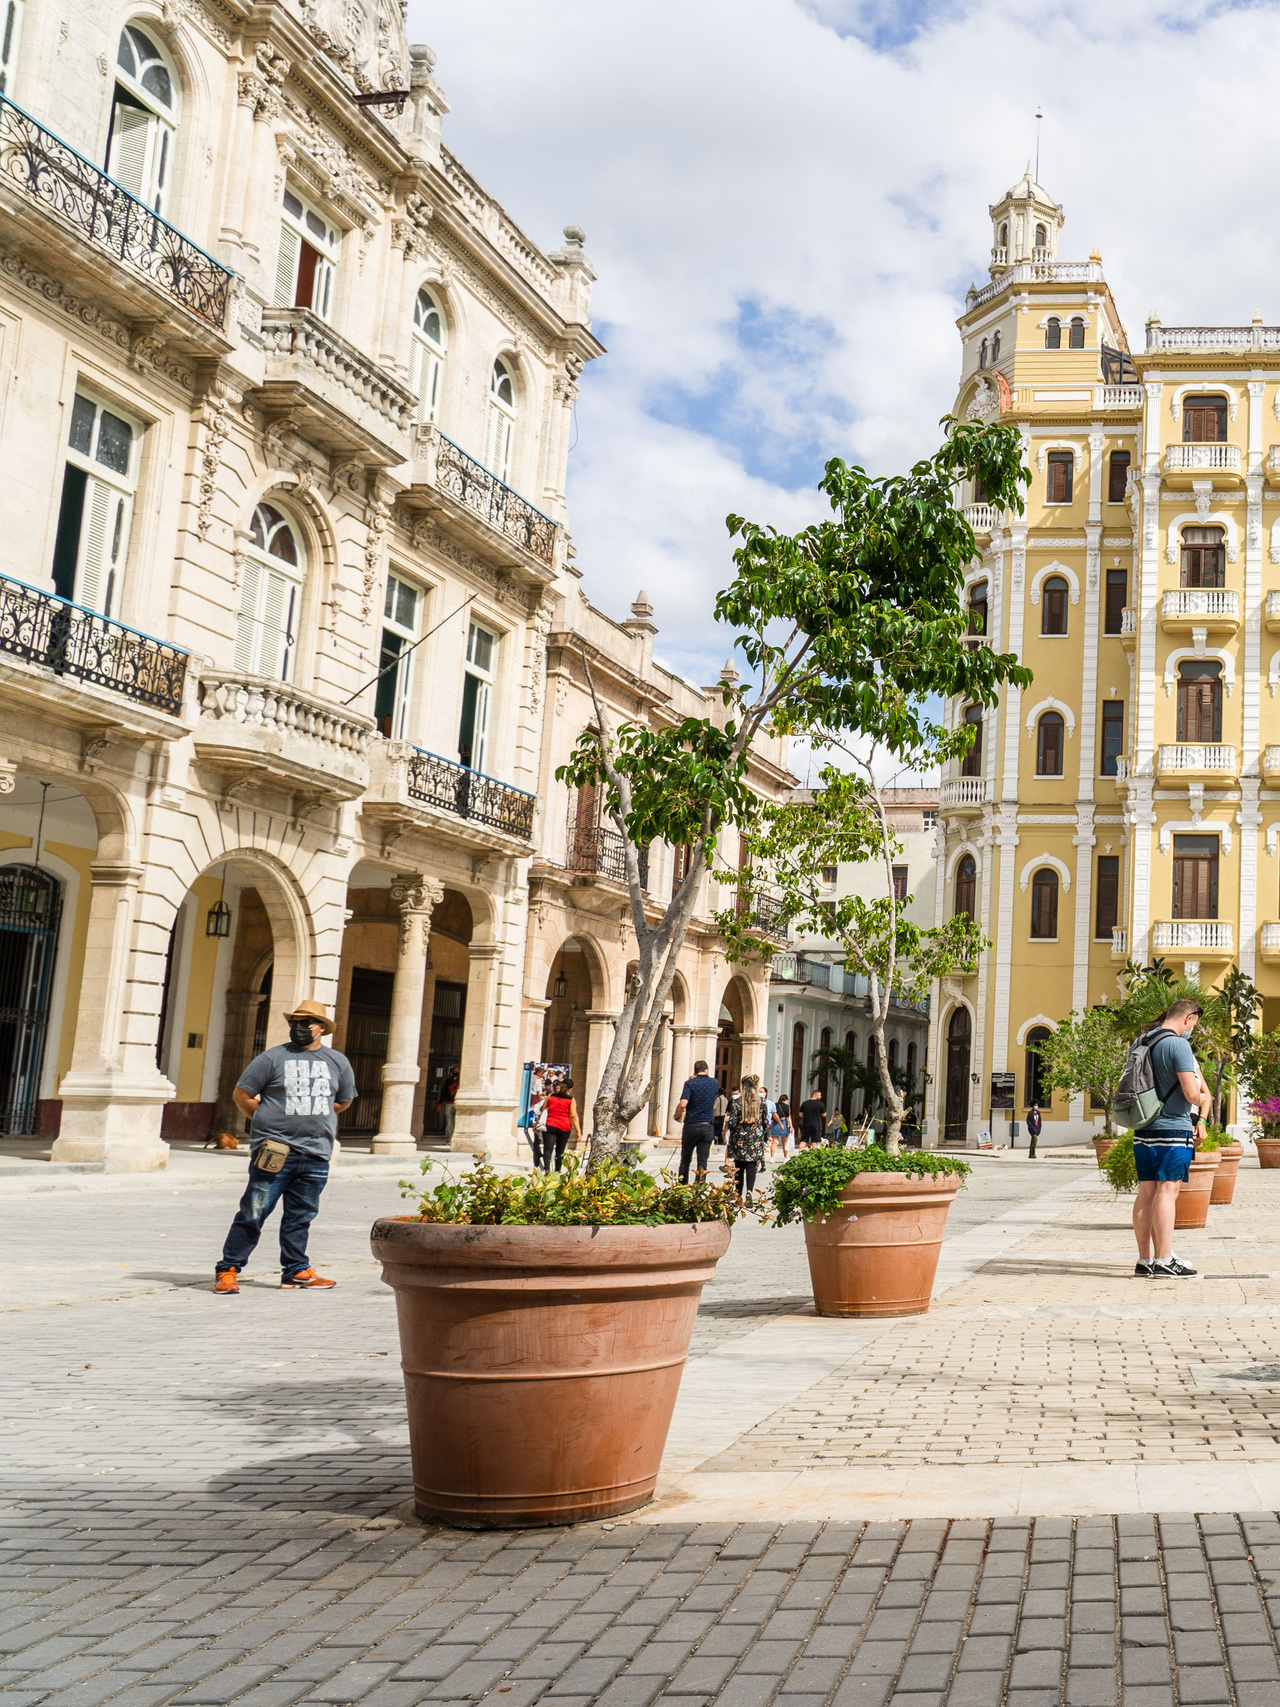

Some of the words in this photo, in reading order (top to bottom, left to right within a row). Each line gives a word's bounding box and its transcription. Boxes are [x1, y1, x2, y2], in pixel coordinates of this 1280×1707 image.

[284, 1060, 331, 1079] HA
[284, 1077, 331, 1096] BA
[285, 1096, 330, 1115] NA
